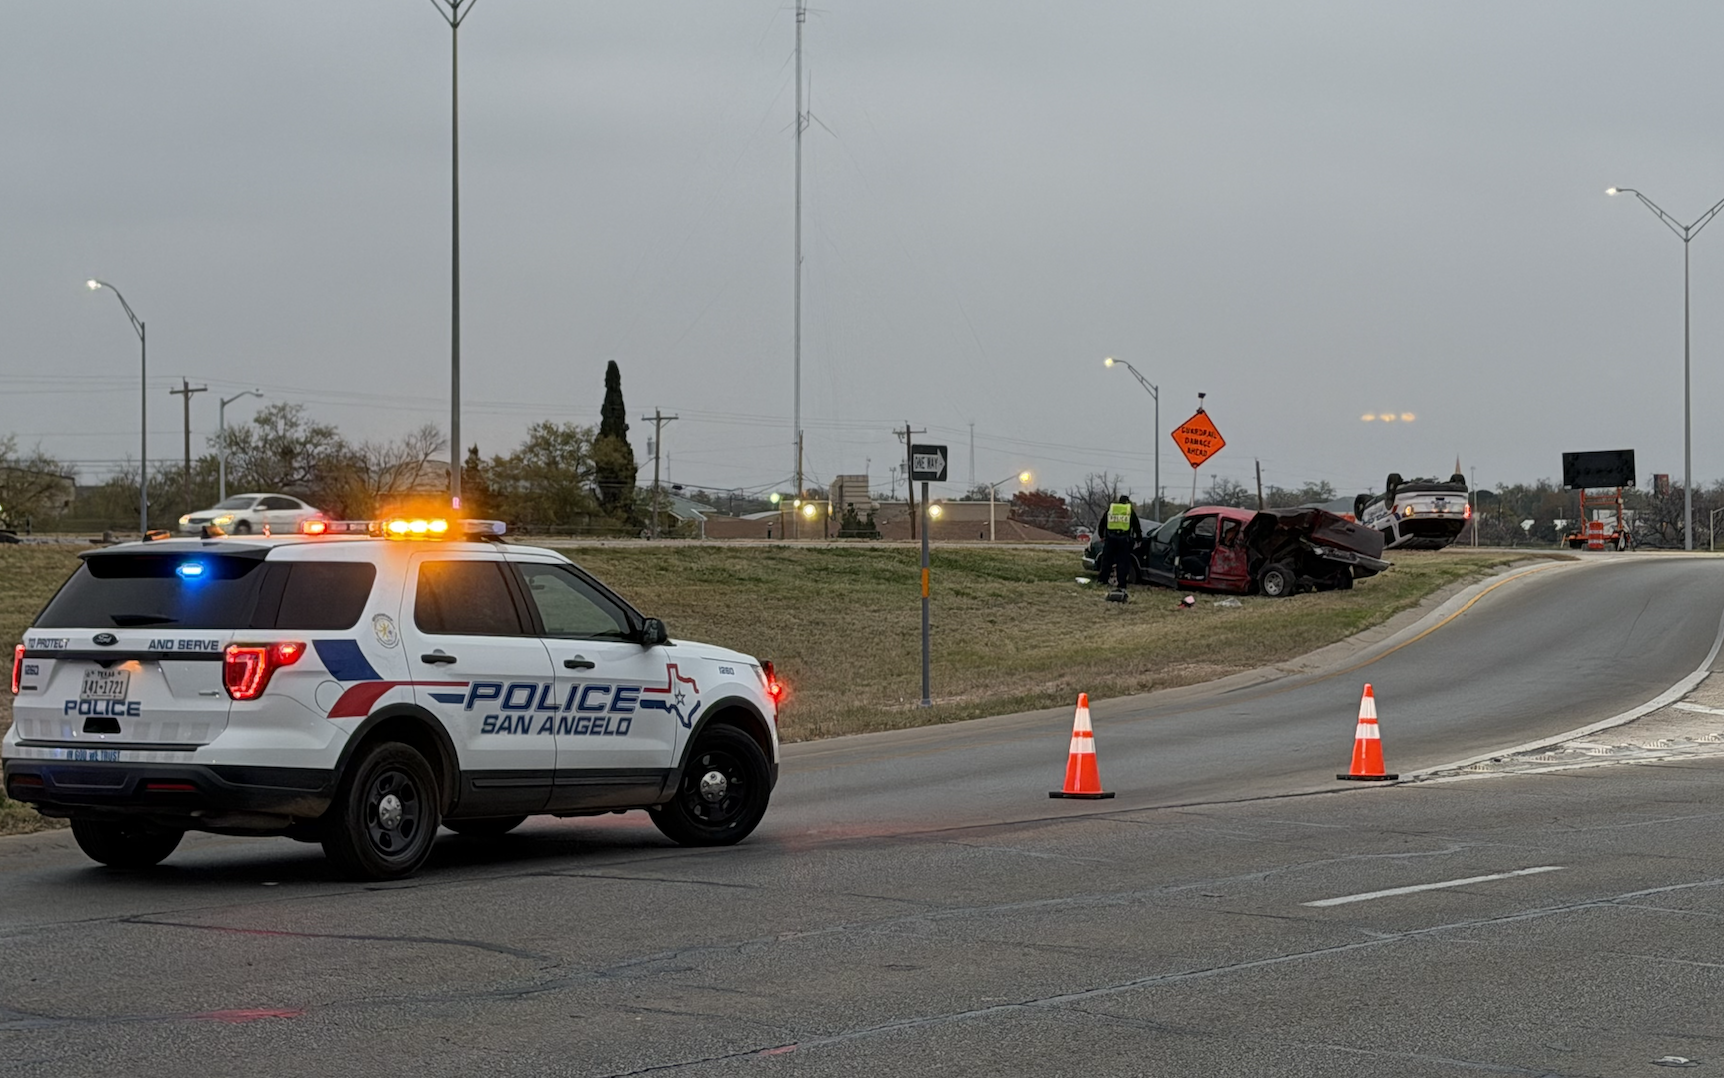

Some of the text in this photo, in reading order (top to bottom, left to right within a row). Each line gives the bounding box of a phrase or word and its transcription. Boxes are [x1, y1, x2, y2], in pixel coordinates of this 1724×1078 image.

[1184, 437, 1212, 448] DAMAGE
[1187, 447, 1208, 457] AHEAD
[915, 456, 938, 470] ONE WAY
[35, 638, 70, 649] PROTECT
[96, 634, 113, 644] Ford
[148, 639, 219, 651] AND SERVE
[97, 670, 115, 678] TEXAS
[718, 666, 735, 676] 1260
[464, 681, 644, 714] POLICE
[64, 700, 141, 717] POLICE
[481, 714, 632, 736] SAN ANGELO
[101, 750, 120, 762] TRUST
